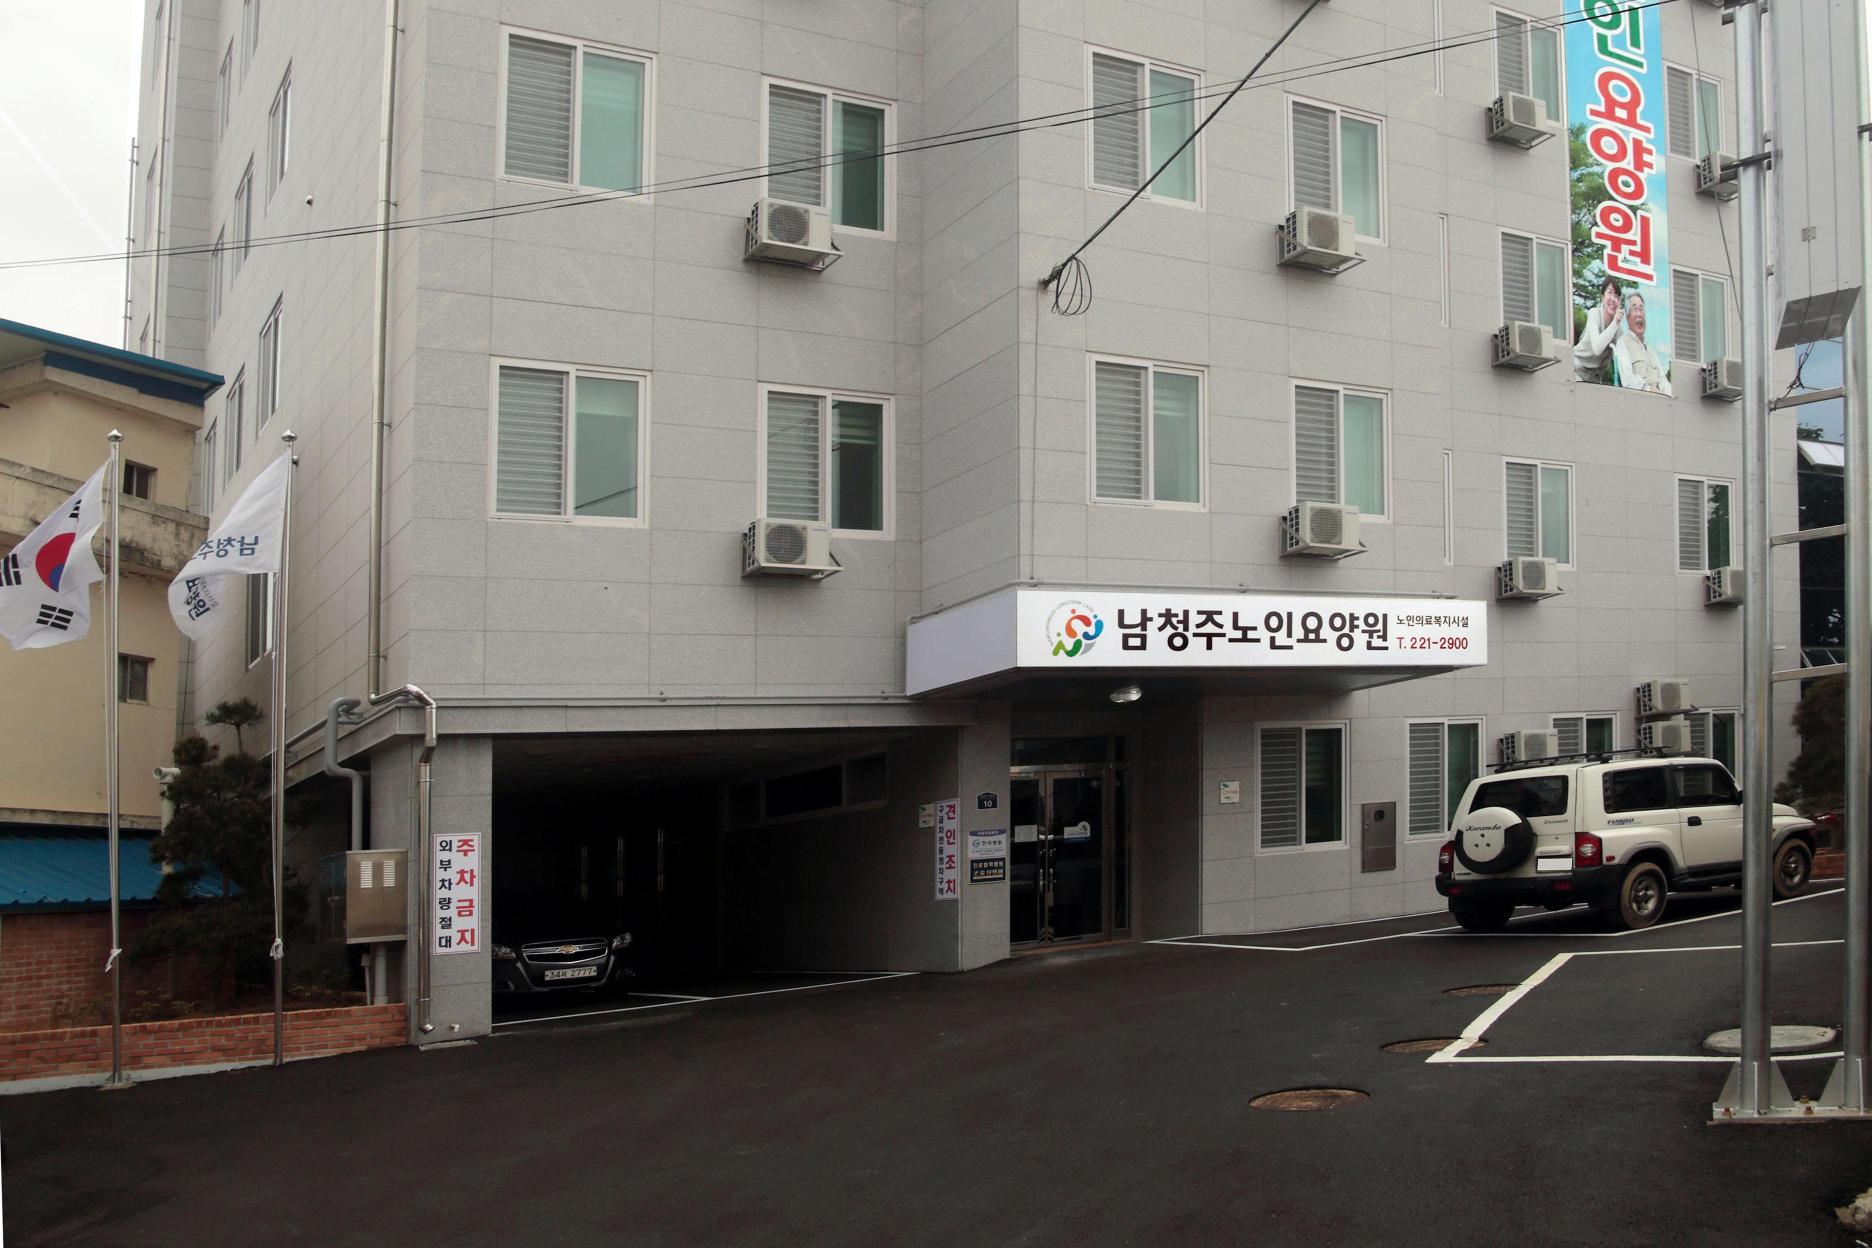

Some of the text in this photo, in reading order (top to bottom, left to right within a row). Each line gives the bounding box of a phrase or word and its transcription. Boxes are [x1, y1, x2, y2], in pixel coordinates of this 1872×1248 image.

[1116, 608, 1390, 652] 남청주노인요양원
[1396, 614, 1469, 629] 노인의료복지시설
[1396, 635, 1469, 650] T. 221-2900
[983, 799, 993, 808] 10
[945, 803, 957, 895] 견인조치
[437, 839, 453, 949] 외부차량절대
[455, 838, 476, 947] 주차금지
